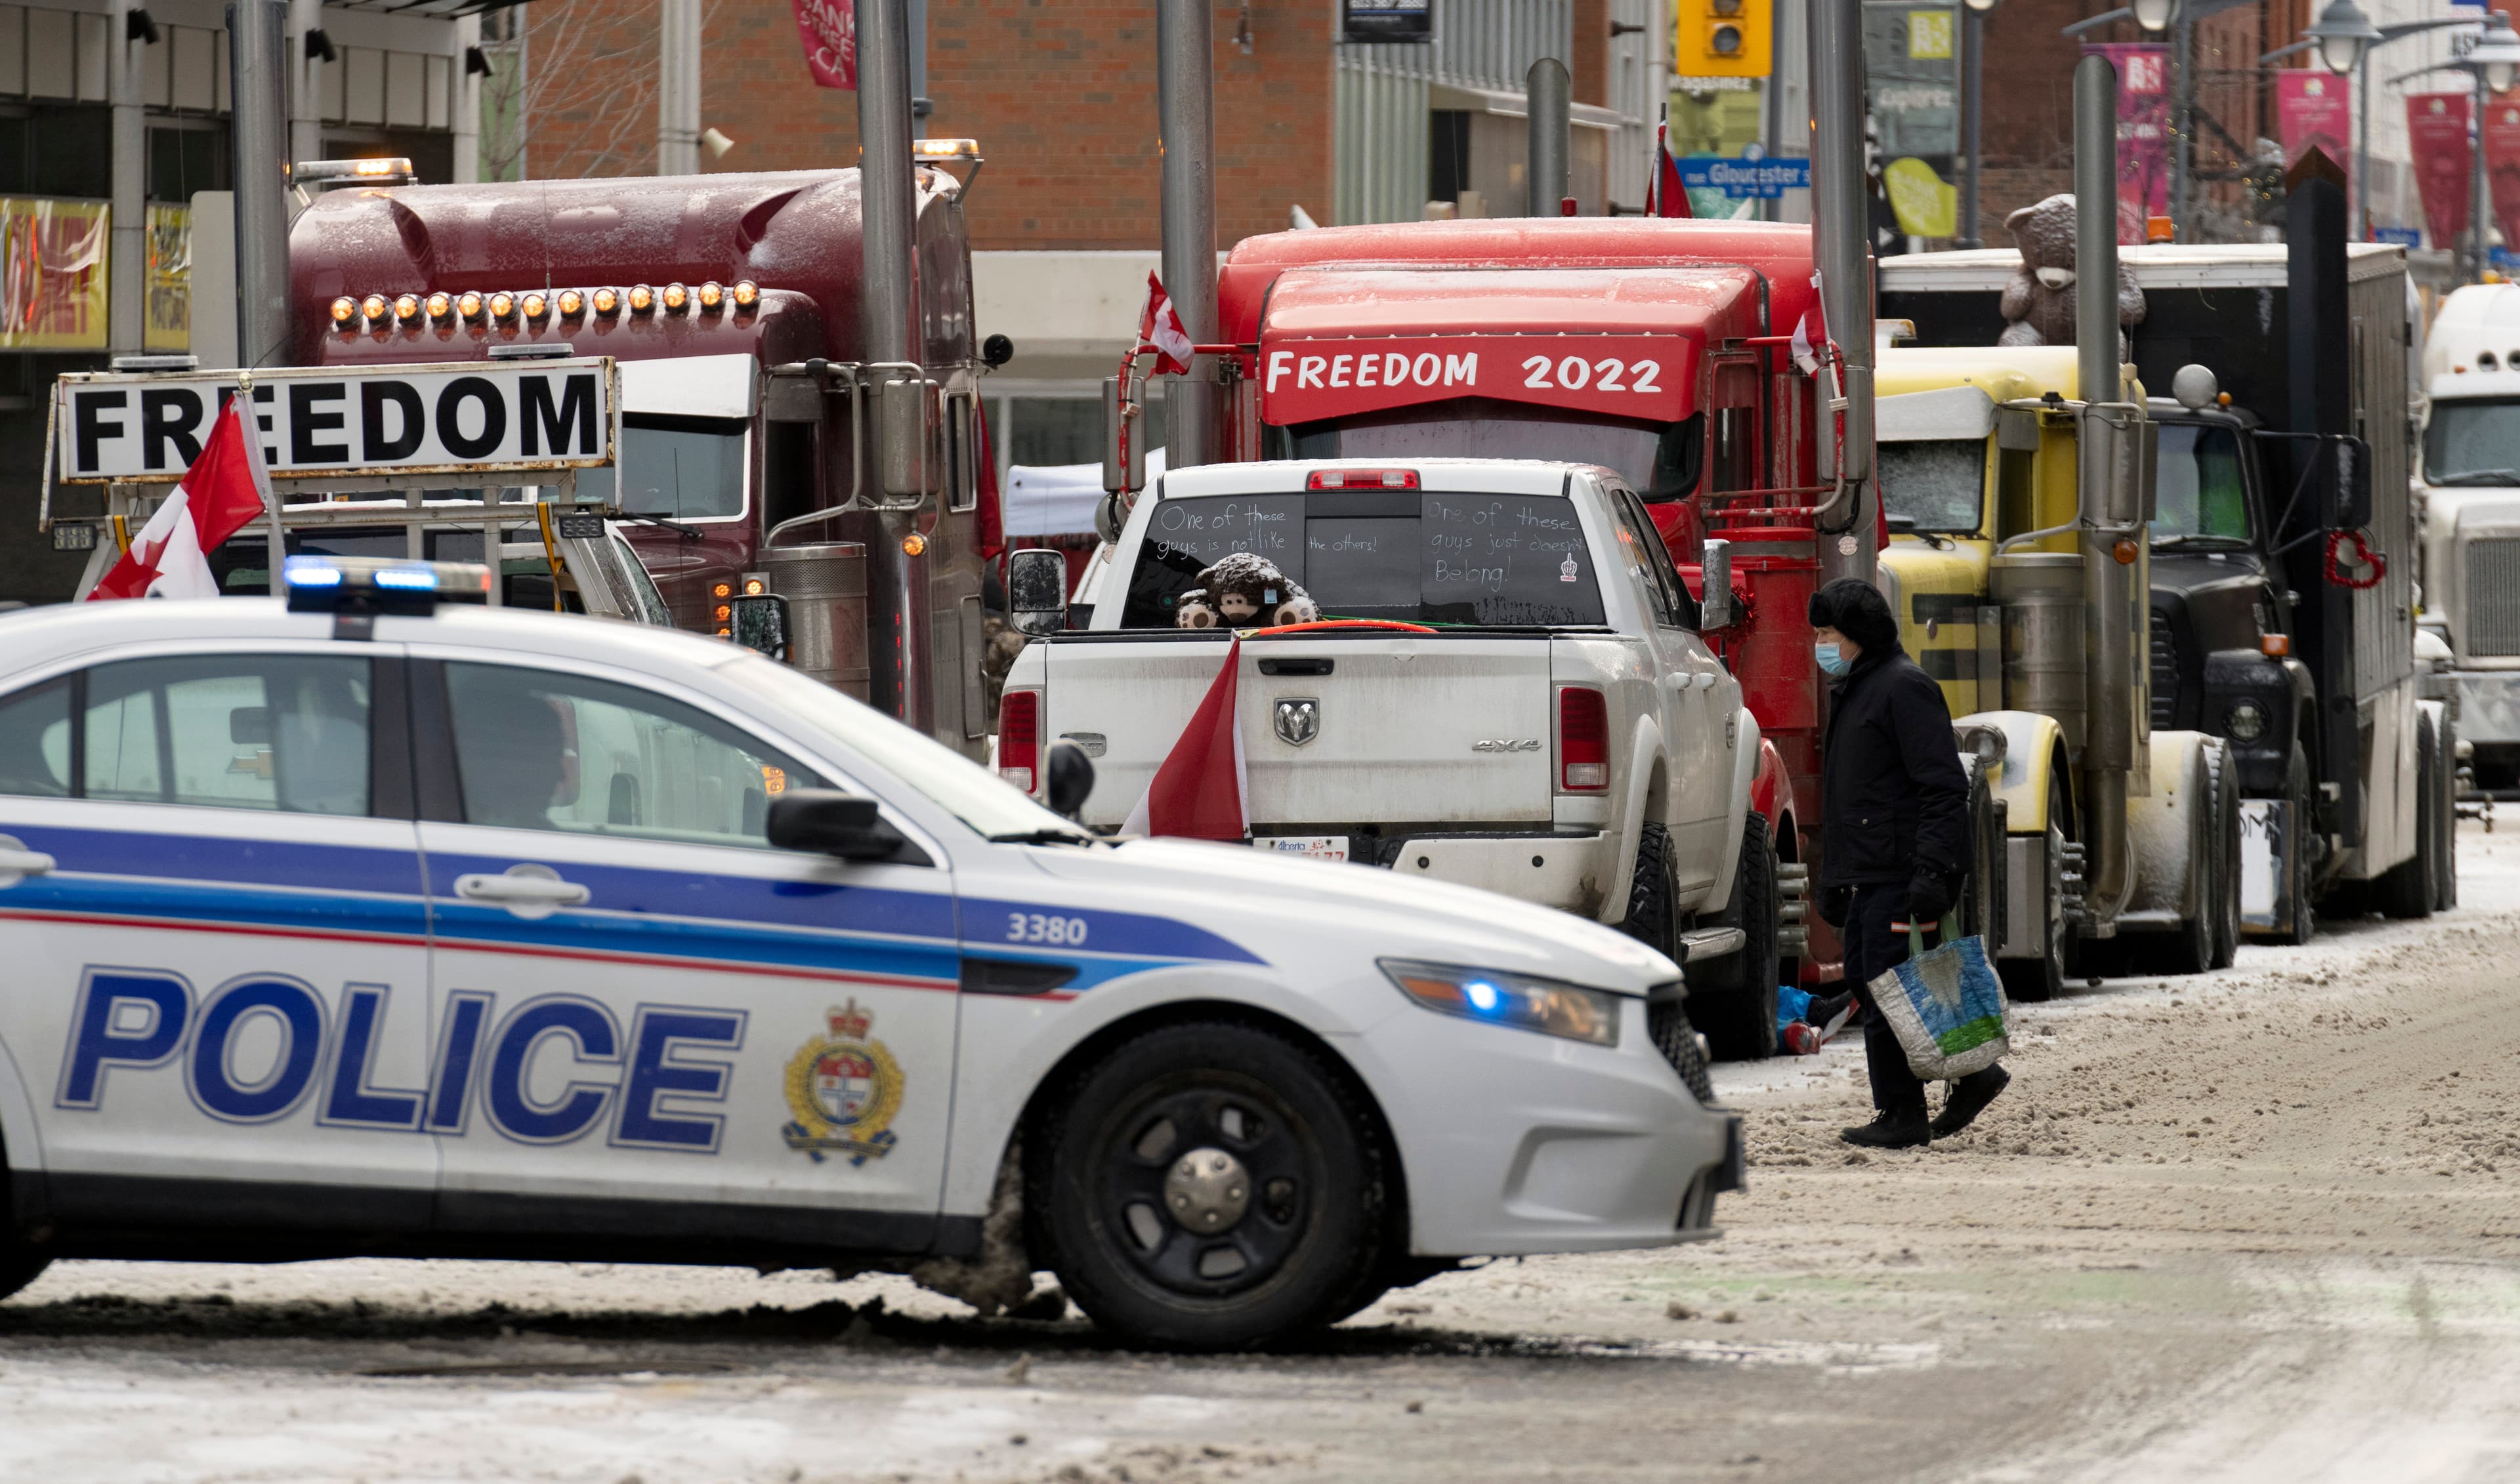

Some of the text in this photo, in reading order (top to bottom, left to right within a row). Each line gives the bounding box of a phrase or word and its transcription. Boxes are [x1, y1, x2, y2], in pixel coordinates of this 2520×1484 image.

[799, 10, 855, 62] STREE
[1685, 173, 1706, 184] rue
[1709, 162, 1800, 184] Gloucester
[1267, 351, 1662, 393] FREEDOM 2022
[1161, 504, 1286, 530] One of these
[1428, 501, 1575, 529] One of these
[1157, 539, 1198, 560] guys
[1208, 539, 1219, 552] is
[1309, 536, 1326, 550] the
[1333, 533, 1377, 552] others!
[1431, 534, 1473, 554] guys
[1486, 531, 1523, 555] just
[1436, 556, 1511, 592] Belong!
[1278, 839, 1305, 851] Alberta
[1006, 912, 1087, 946] 3380
[54, 964, 749, 1154] POLICE
